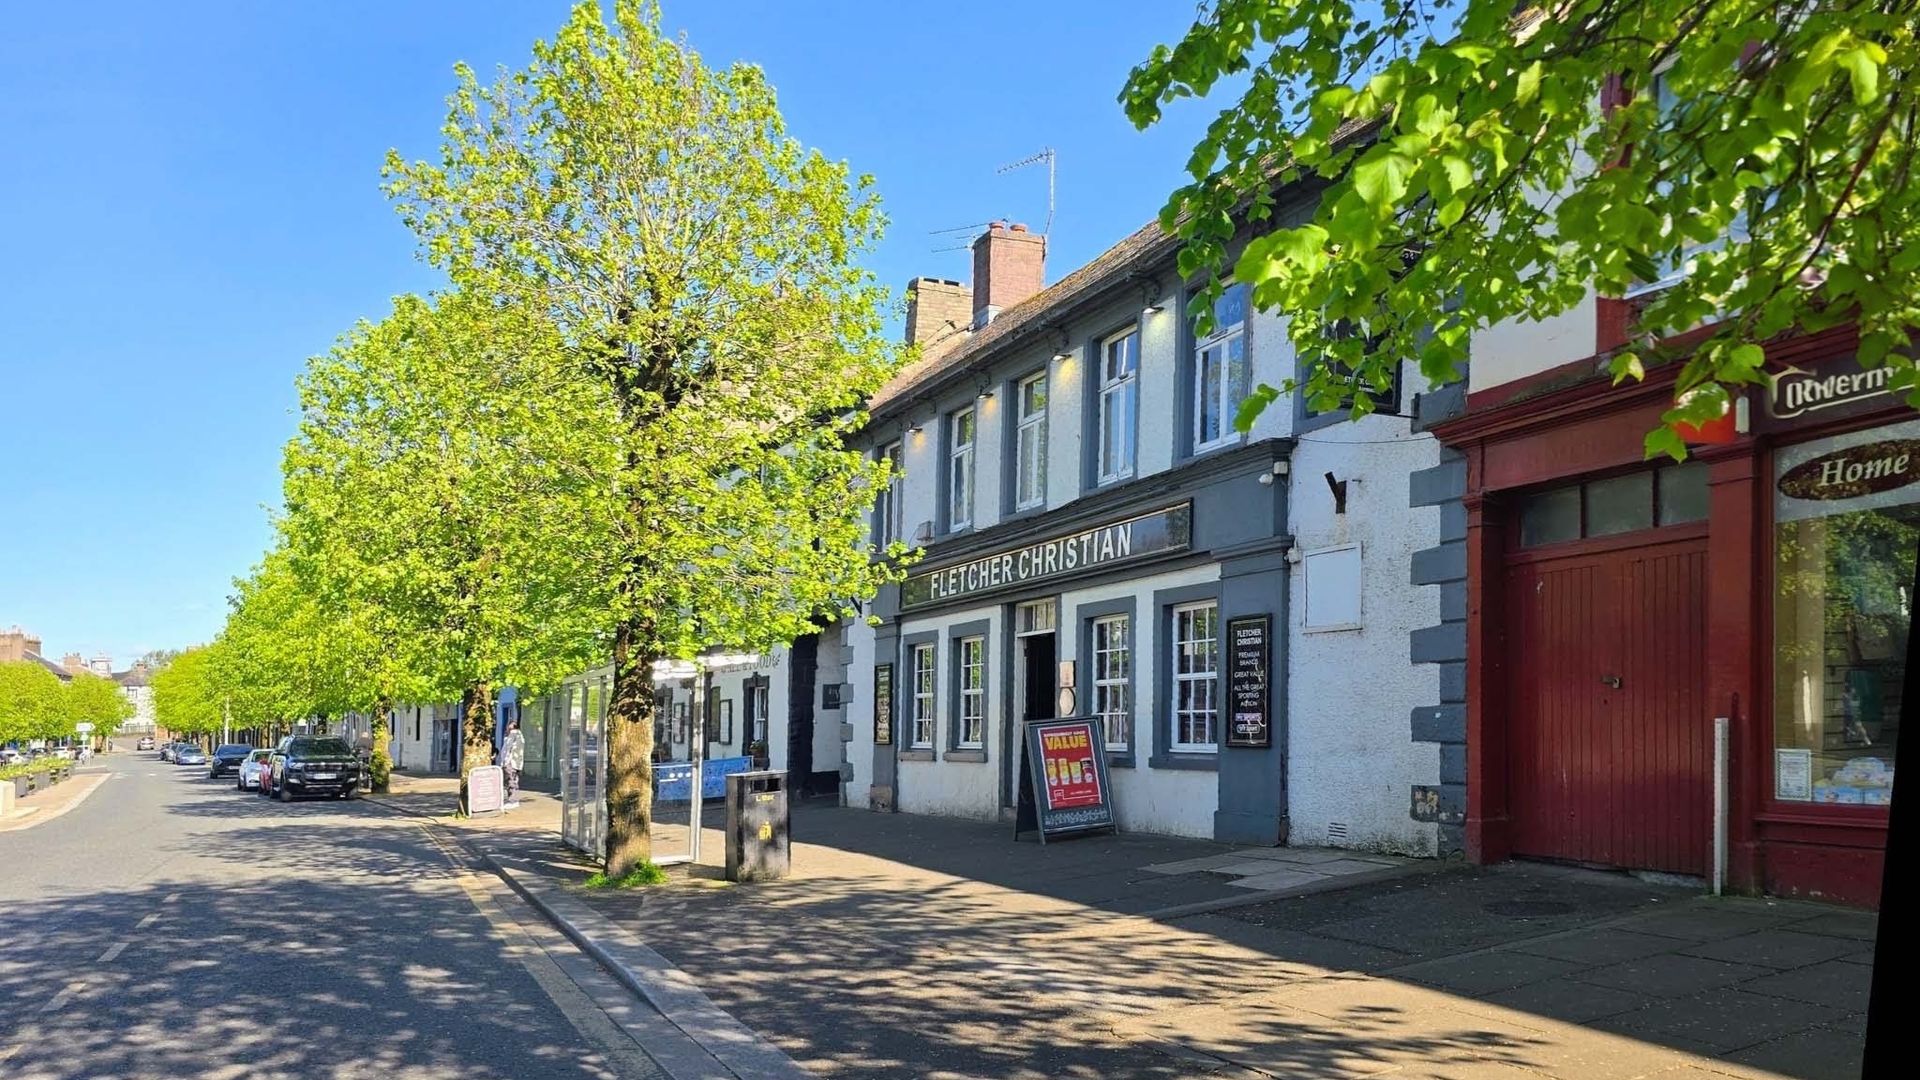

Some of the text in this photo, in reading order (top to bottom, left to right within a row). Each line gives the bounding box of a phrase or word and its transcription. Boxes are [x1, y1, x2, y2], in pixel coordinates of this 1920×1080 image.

[1785, 366, 1902, 409] Riverm
[1817, 452, 1910, 487] Home
[930, 523, 1133, 600] FLETCHER CHRISTIAN
[1237, 629, 1262, 637] FLETCHER
[1237, 637, 1262, 646] CHRISTIAN
[1045, 735, 1088, 750] VALUE
